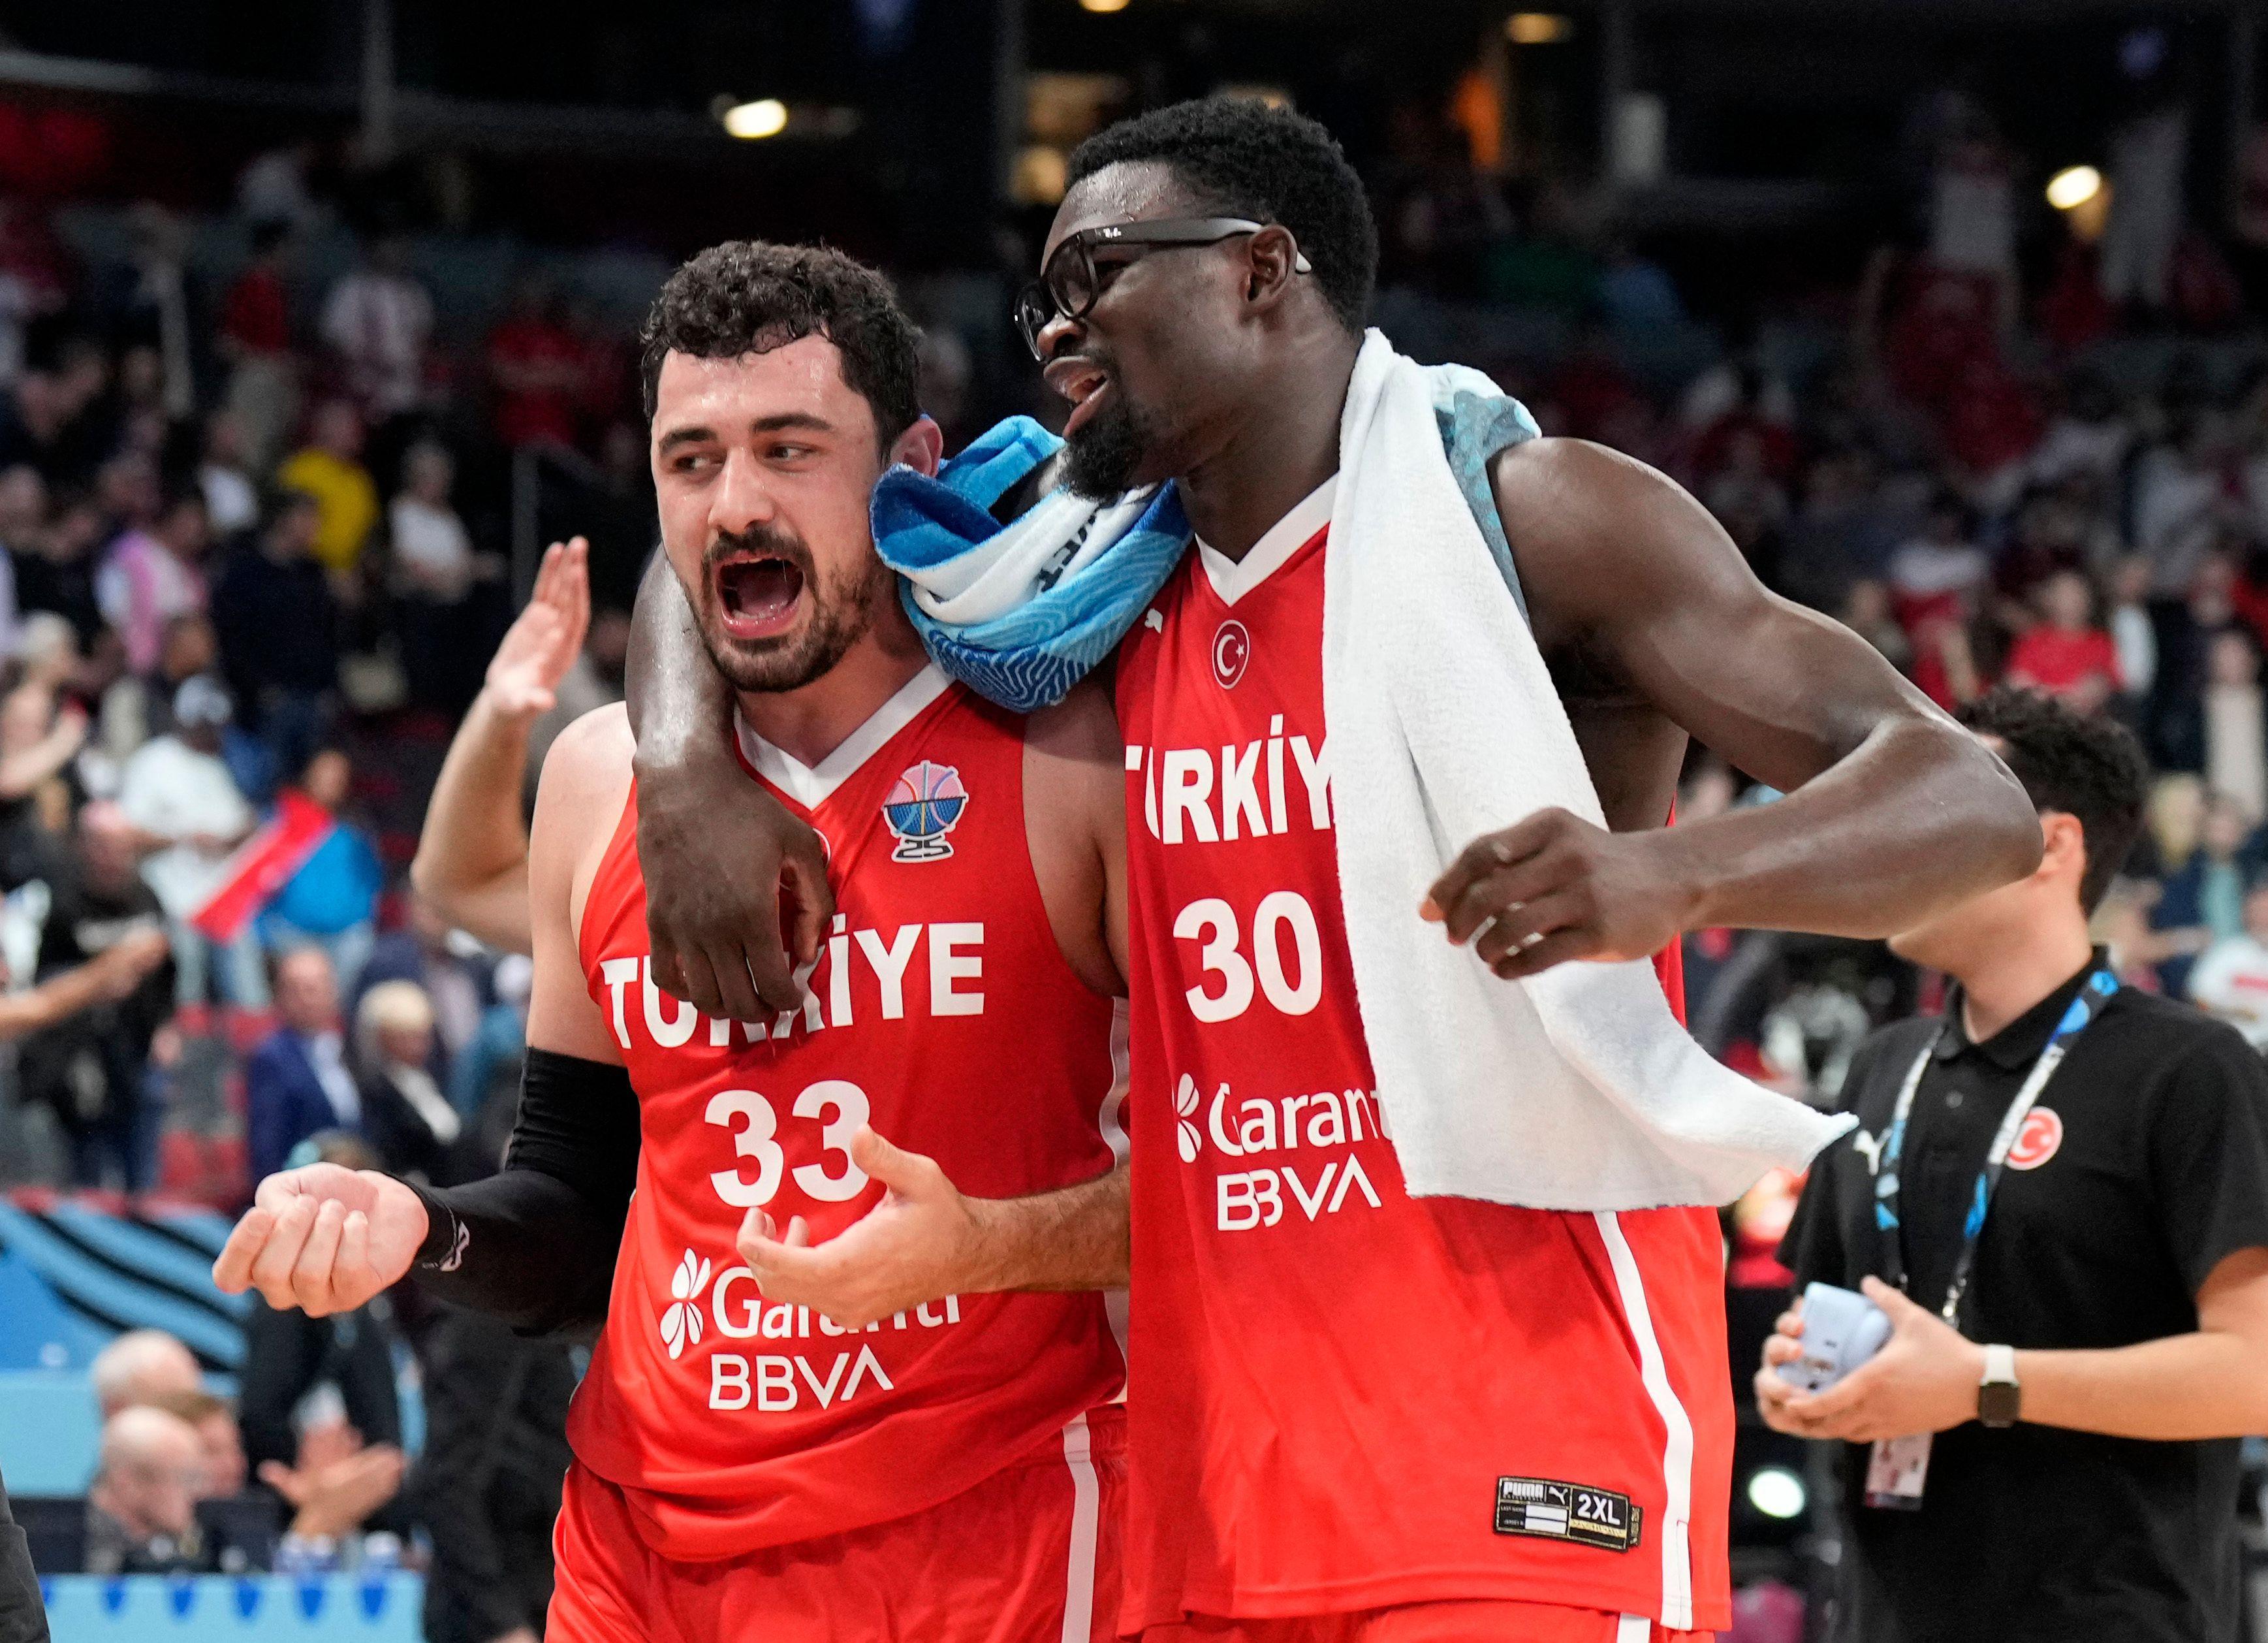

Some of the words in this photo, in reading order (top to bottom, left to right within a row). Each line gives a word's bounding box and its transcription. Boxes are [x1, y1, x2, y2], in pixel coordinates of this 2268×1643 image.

[1126, 714, 1331, 844] RKİY
[600, 912, 984, 1049] TKİYE
[1173, 891, 1323, 1023] 30
[704, 1080, 870, 1207] 33
[1208, 1083, 1393, 1156] Garant
[1217, 1153, 1382, 1232] BBVA
[712, 1266, 961, 1339] Garti
[709, 1343, 894, 1412] BBVA
[1503, 1481, 1544, 1498] PUMA
[1577, 1493, 1620, 1525] 2XL
